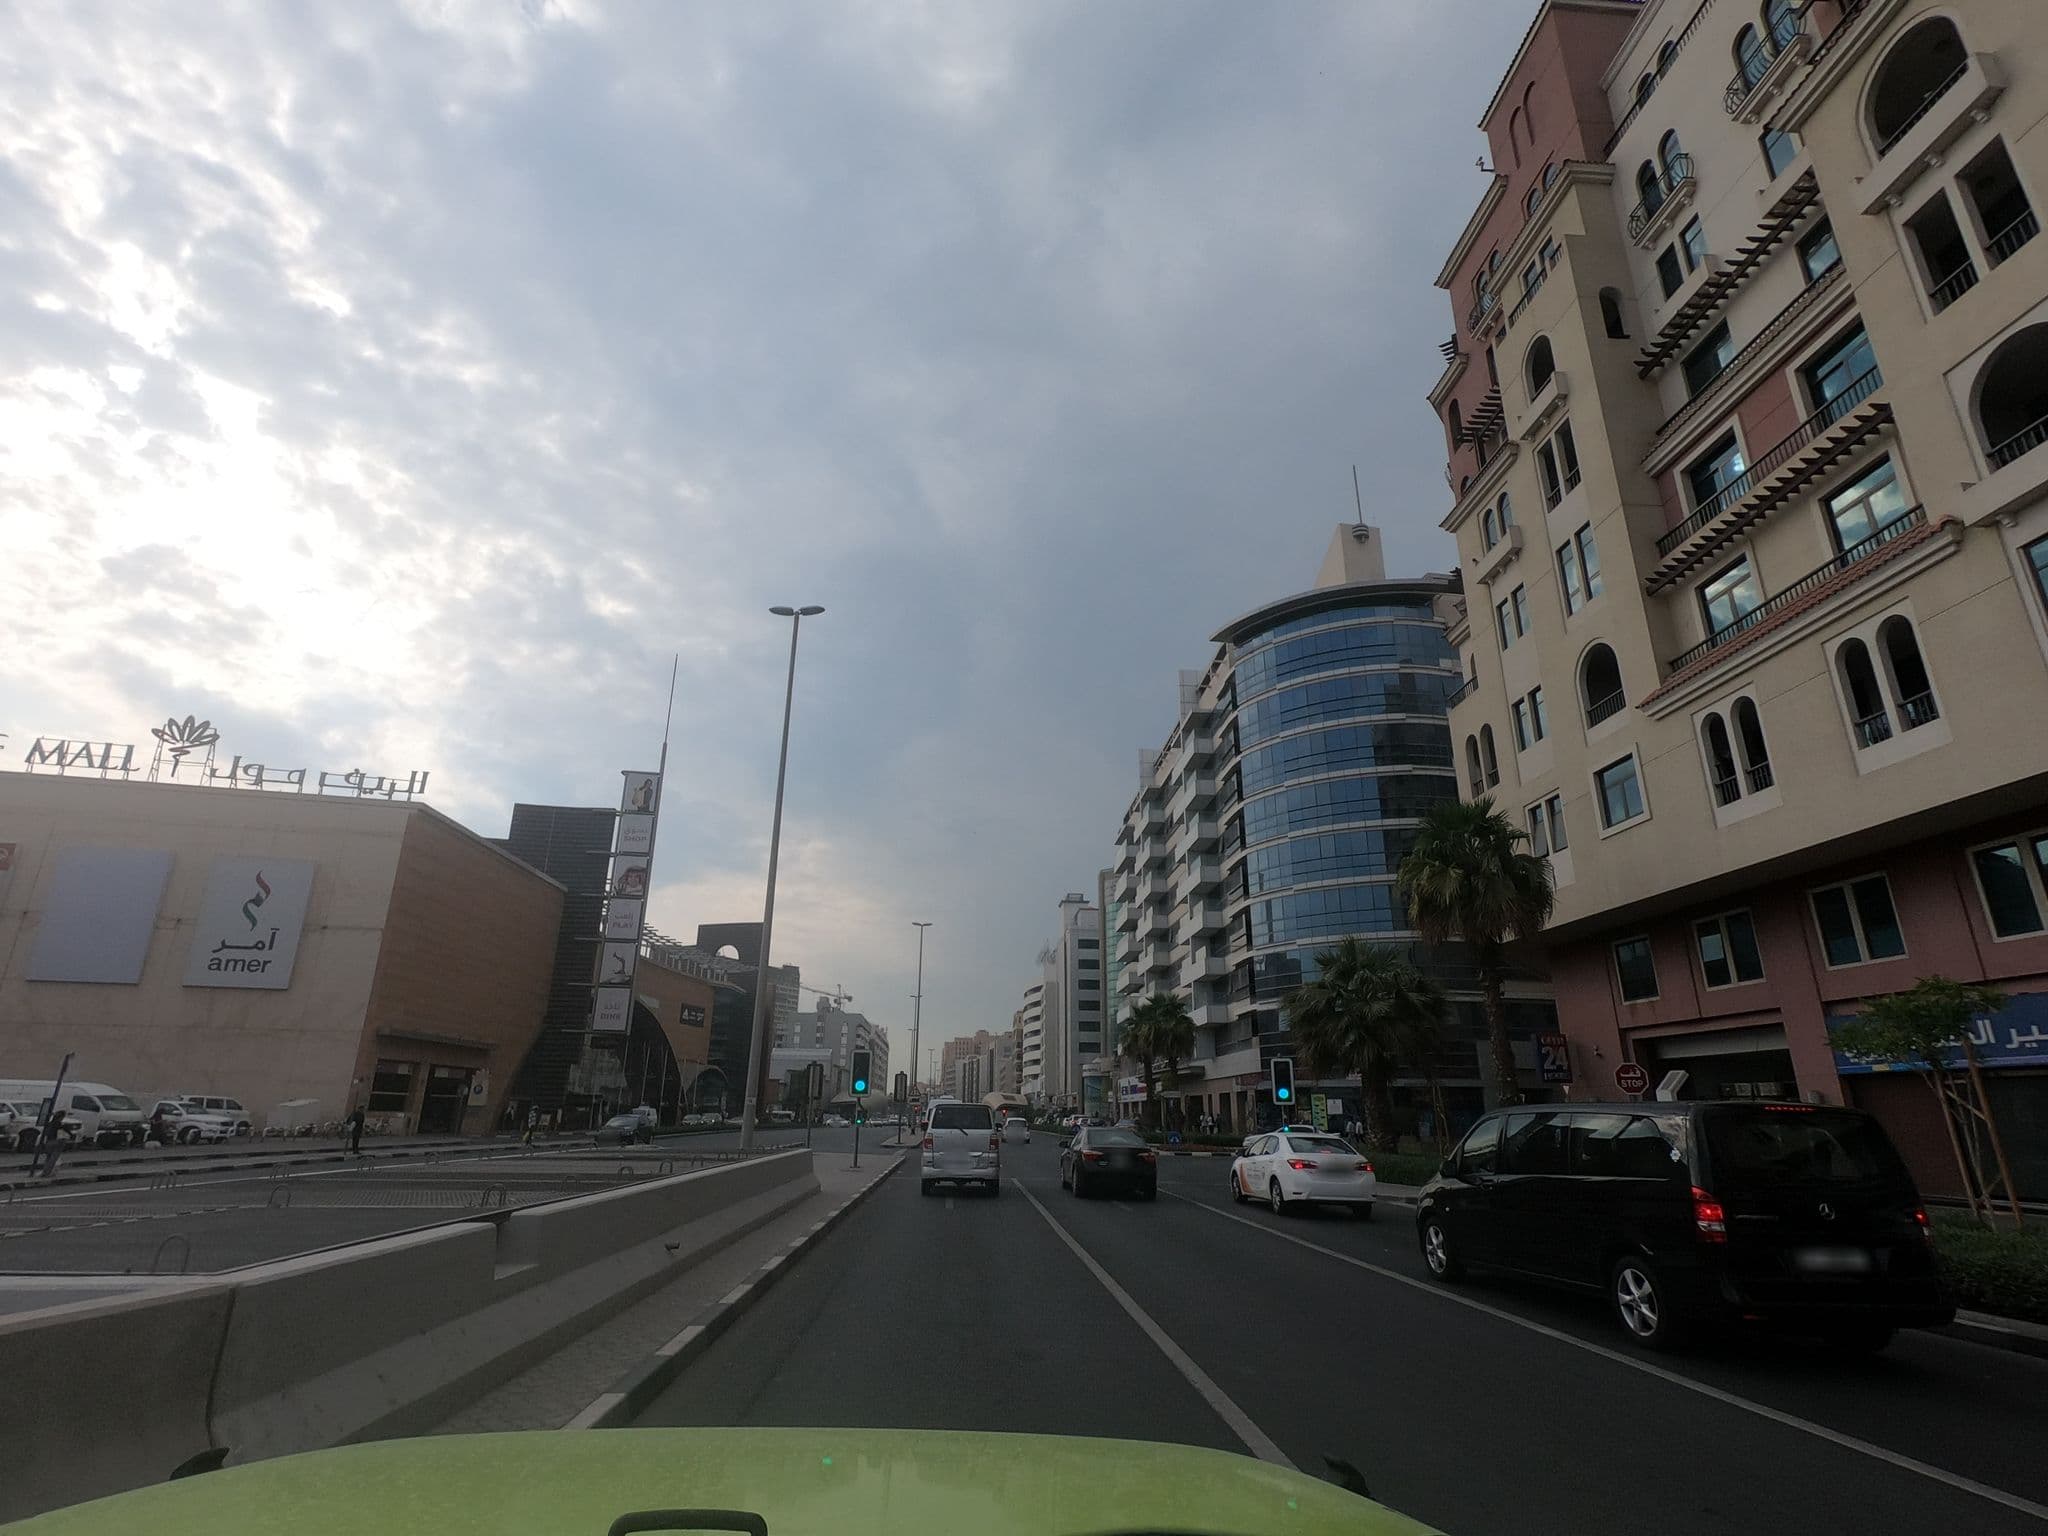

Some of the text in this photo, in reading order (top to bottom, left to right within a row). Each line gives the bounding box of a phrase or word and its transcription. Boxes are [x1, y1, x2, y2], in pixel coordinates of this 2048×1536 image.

[24, 738, 140, 771] MALL
[211, 928, 280, 953] آمر
[208, 957, 272, 973] amer
[1541, 1045, 1569, 1069] 24
[1620, 1067, 1641, 1077] قف
[1620, 1079, 1643, 1088] STOP
